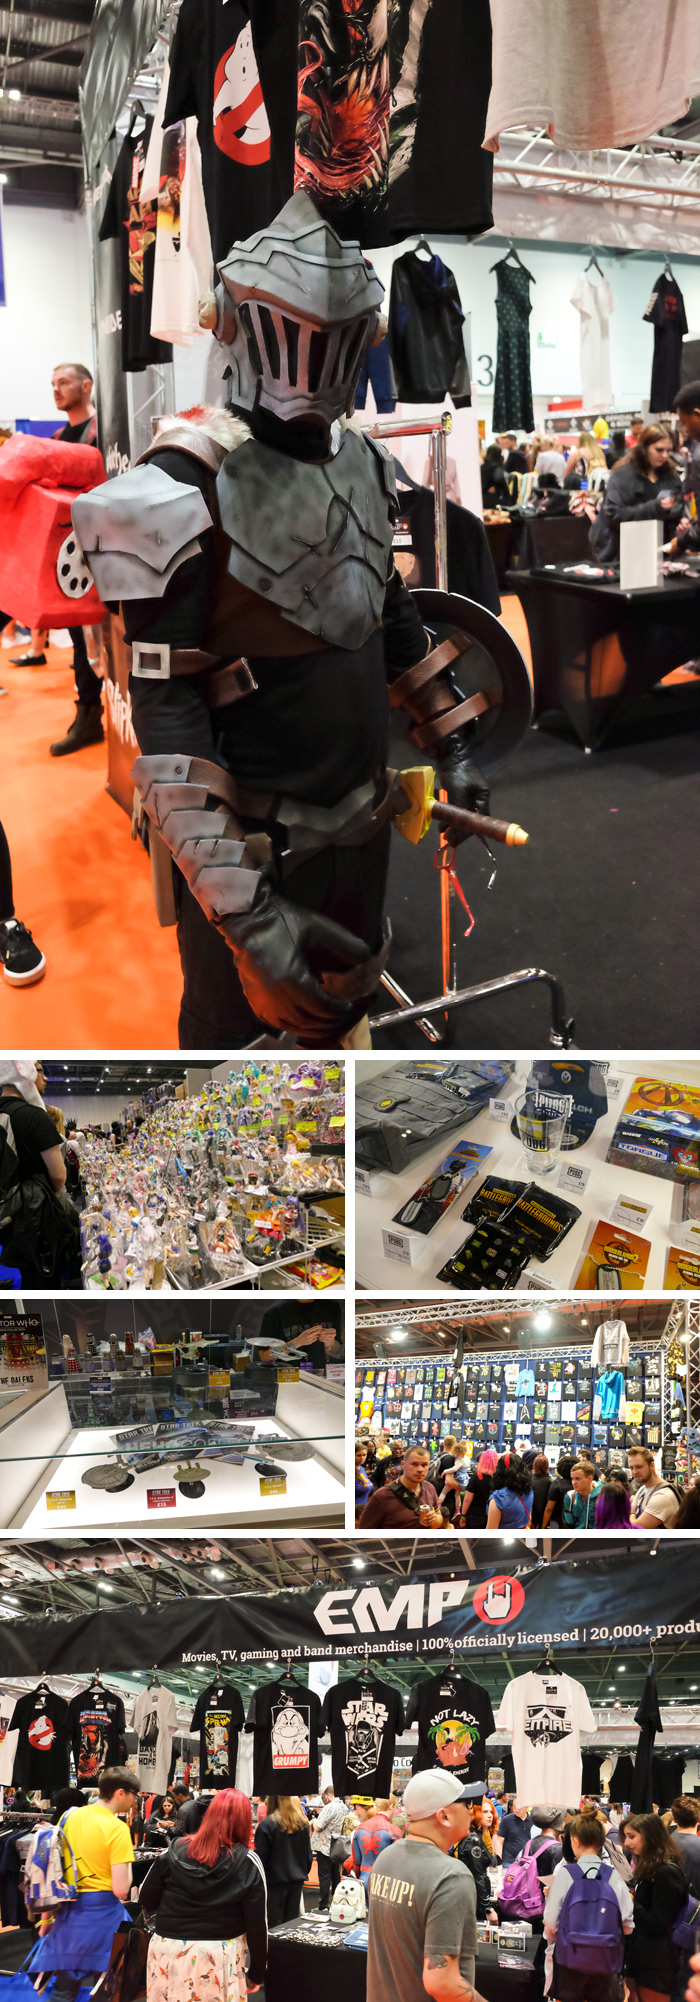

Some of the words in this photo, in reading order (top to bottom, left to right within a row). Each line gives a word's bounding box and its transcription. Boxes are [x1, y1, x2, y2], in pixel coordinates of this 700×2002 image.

[477, 354, 494, 387] 3
[516, 1198, 564, 1233] BATTLEGROUNDS
[118, 1429, 138, 1441] STAR
[140, 1425, 154, 1436] TRE
[160, 1422, 180, 1431] STAR
[208, 1420, 230, 1430] STAR
[313, 1579, 470, 1636] EMP
[181, 1652, 219, 1663] Movies,
[220, 1649, 238, 1662] TV,
[240, 1647, 279, 1662] gaming
[281, 1645, 302, 1658] and
[303, 1644, 333, 1658] band
[335, 1639, 414, 1655] merchandise
[422, 1636, 454, 1651] 100%
[454, 1632, 516, 1649] officially
[517, 1627, 580, 1645] licensed
[590, 1623, 652, 1641] 20,000+
[341, 1700, 389, 1717] STAR
[430, 1708, 451, 1727] NOT
[453, 1708, 480, 1726] LAZY
[524, 1719, 573, 1733] EMPIRE
[274, 1756, 308, 1766] GRUMPY
[389, 1878, 415, 1908] UP!
